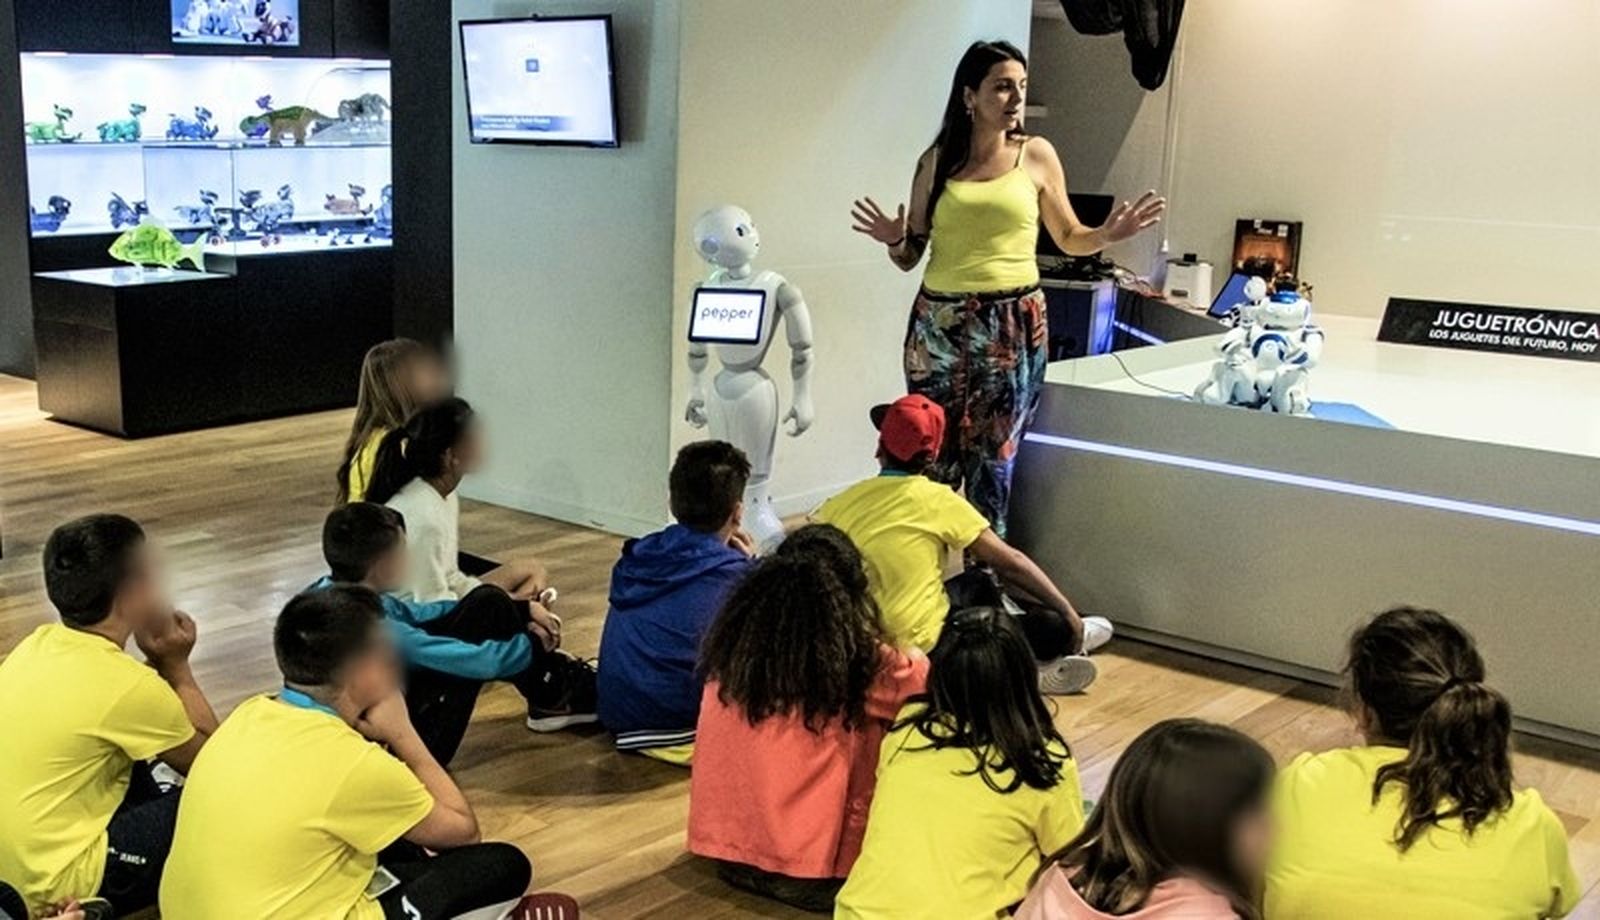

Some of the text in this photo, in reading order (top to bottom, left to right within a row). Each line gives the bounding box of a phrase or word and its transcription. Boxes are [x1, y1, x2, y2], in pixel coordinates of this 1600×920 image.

[701, 307, 753, 323] pepper
[1432, 310, 1600, 340] JUGUETRÓNICA
[1429, 328, 1449, 339] LOS
[1450, 331, 1500, 345] JUGUETES
[1502, 335, 1521, 346] DEL
[1571, 342, 1598, 353] HOY
